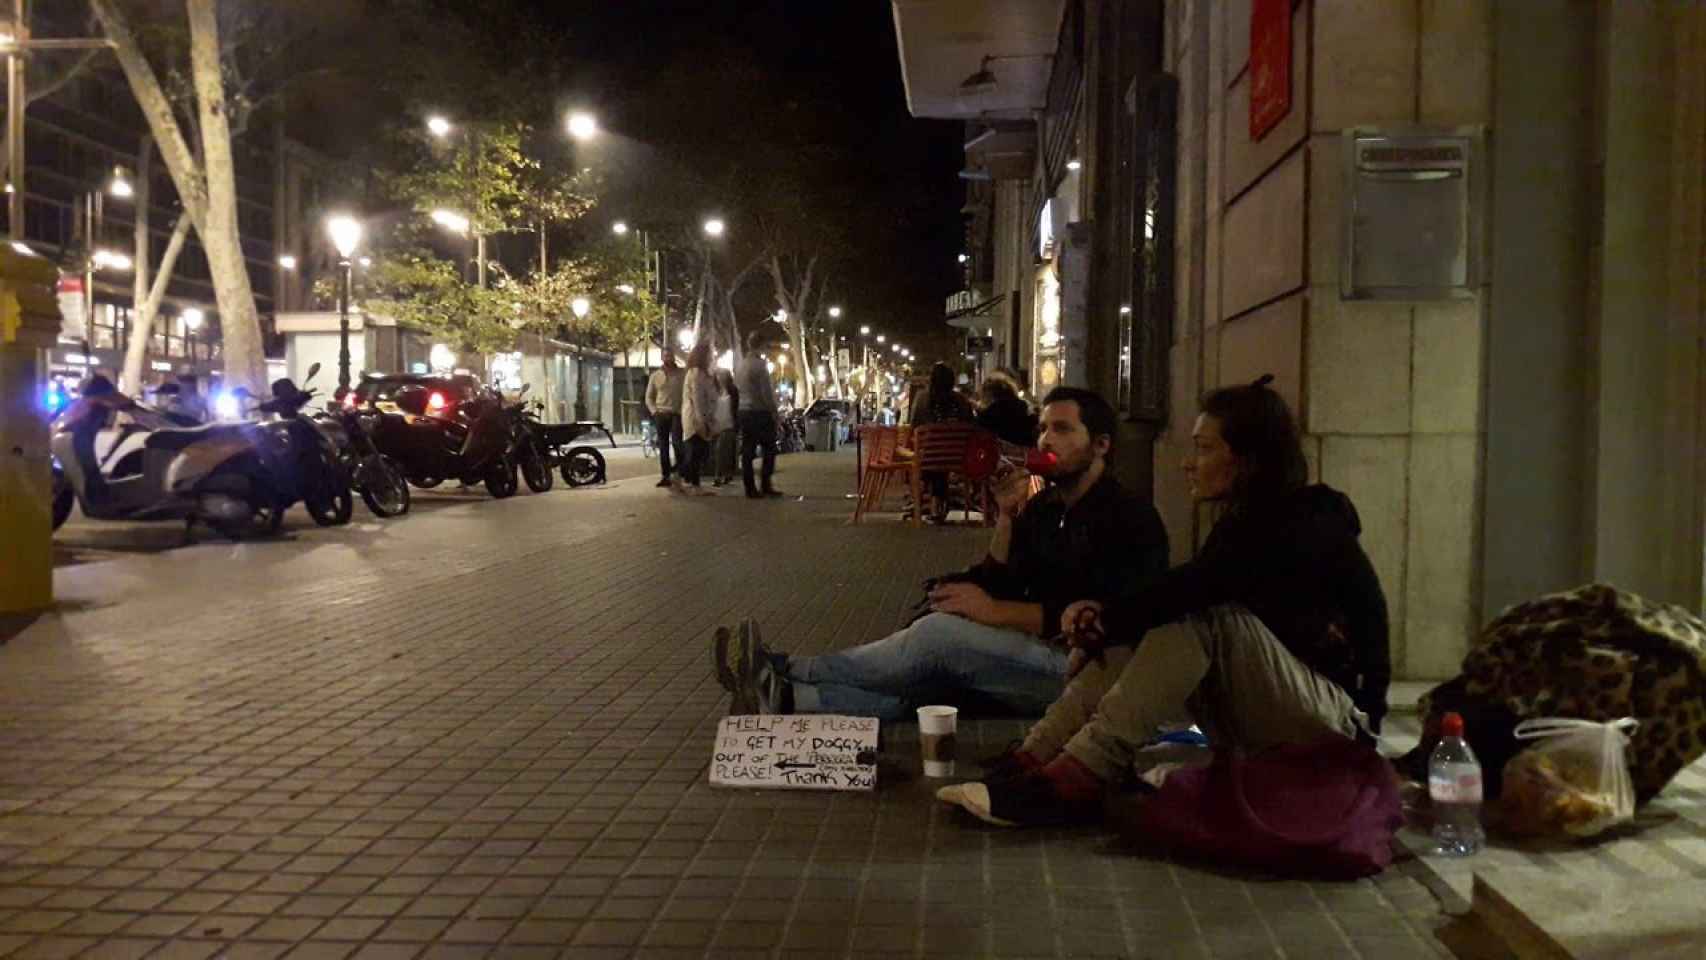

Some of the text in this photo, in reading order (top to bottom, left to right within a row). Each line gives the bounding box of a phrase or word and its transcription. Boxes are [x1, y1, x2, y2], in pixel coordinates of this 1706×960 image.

[727, 717, 874, 734] HELP ME PLEASE
[723, 737, 738, 748] TO
[747, 736, 776, 750] GET
[783, 737, 807, 749] MY
[715, 753, 745, 763] OUT
[752, 753, 769, 763] OF
[716, 763, 773, 780] PLEASE!
[780, 769, 837, 785] Thank
